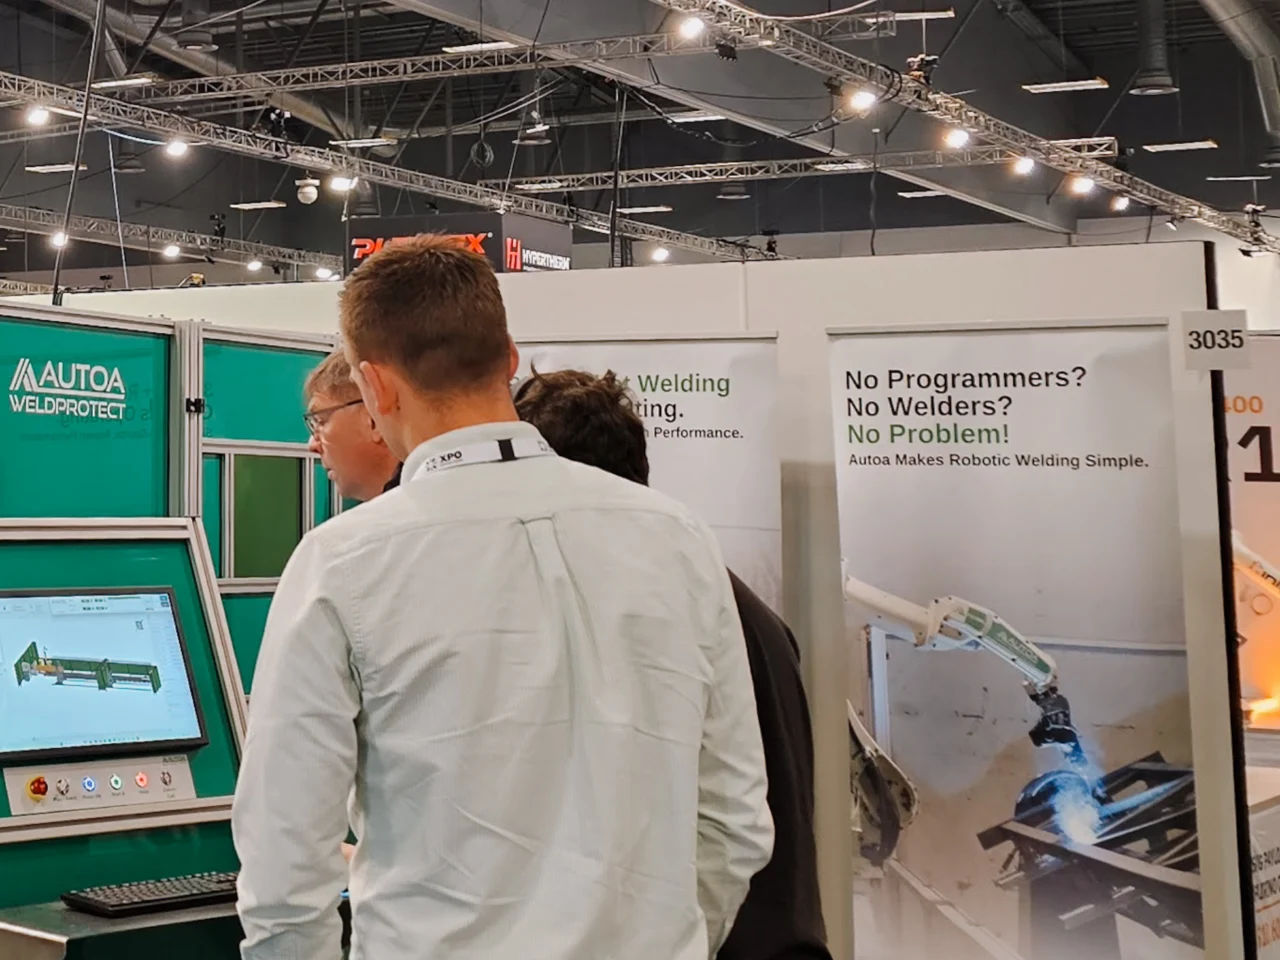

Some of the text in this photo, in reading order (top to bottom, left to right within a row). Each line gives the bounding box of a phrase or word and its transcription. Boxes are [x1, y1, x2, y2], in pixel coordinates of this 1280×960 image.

[1188, 329, 1244, 350] 3035
[39, 360, 125, 394] AUTOA
[637, 373, 731, 397] Welding
[845, 366, 1087, 394] No Programmers?
[9, 394, 126, 420] WELDPROTECT
[847, 395, 1012, 417] No Welders?
[654, 426, 744, 439] Performance.
[848, 422, 1009, 444] No Problem!
[440, 450, 463, 464] XPO
[849, 454, 1149, 470] Autoa Makes Robotic Welding Simple.
